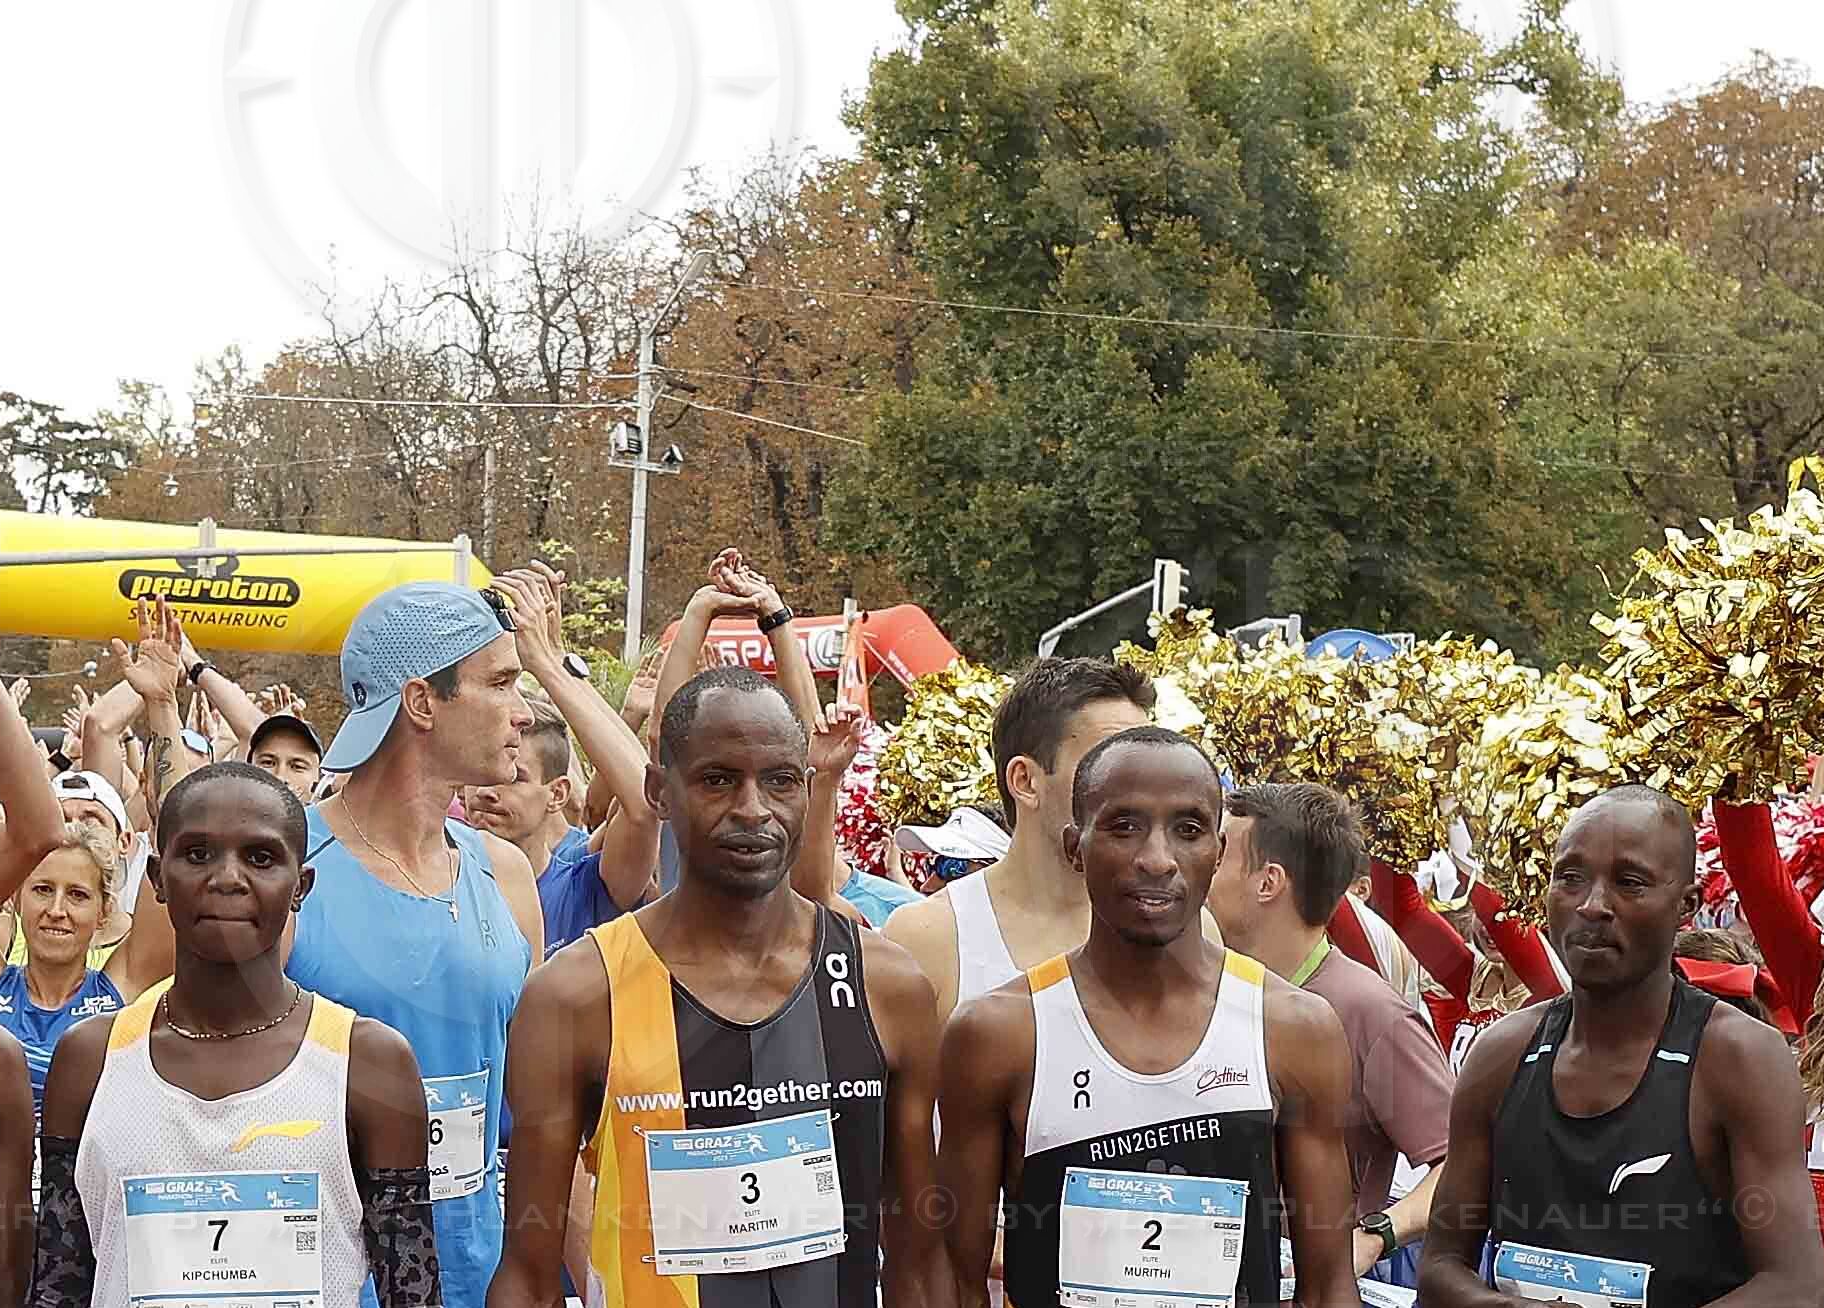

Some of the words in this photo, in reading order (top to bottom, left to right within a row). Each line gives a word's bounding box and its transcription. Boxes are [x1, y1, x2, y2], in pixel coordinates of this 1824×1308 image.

[616, 1077, 882, 1113] www.run2gether.com
[694, 1136, 732, 1149] GRAZ
[1089, 1117, 1222, 1162] RUN2GETHER
[166, 1181, 205, 1193] GRAZ
[740, 1172, 761, 1204] 3
[1107, 1178, 1144, 1191] GRAZ
[207, 1219, 229, 1251] 7
[728, 1218, 779, 1235] MARITIM
[1141, 1219, 1163, 1250] 2
[182, 1269, 257, 1281] KIPCHUMBA
[1124, 1266, 1171, 1279] MURITHI
